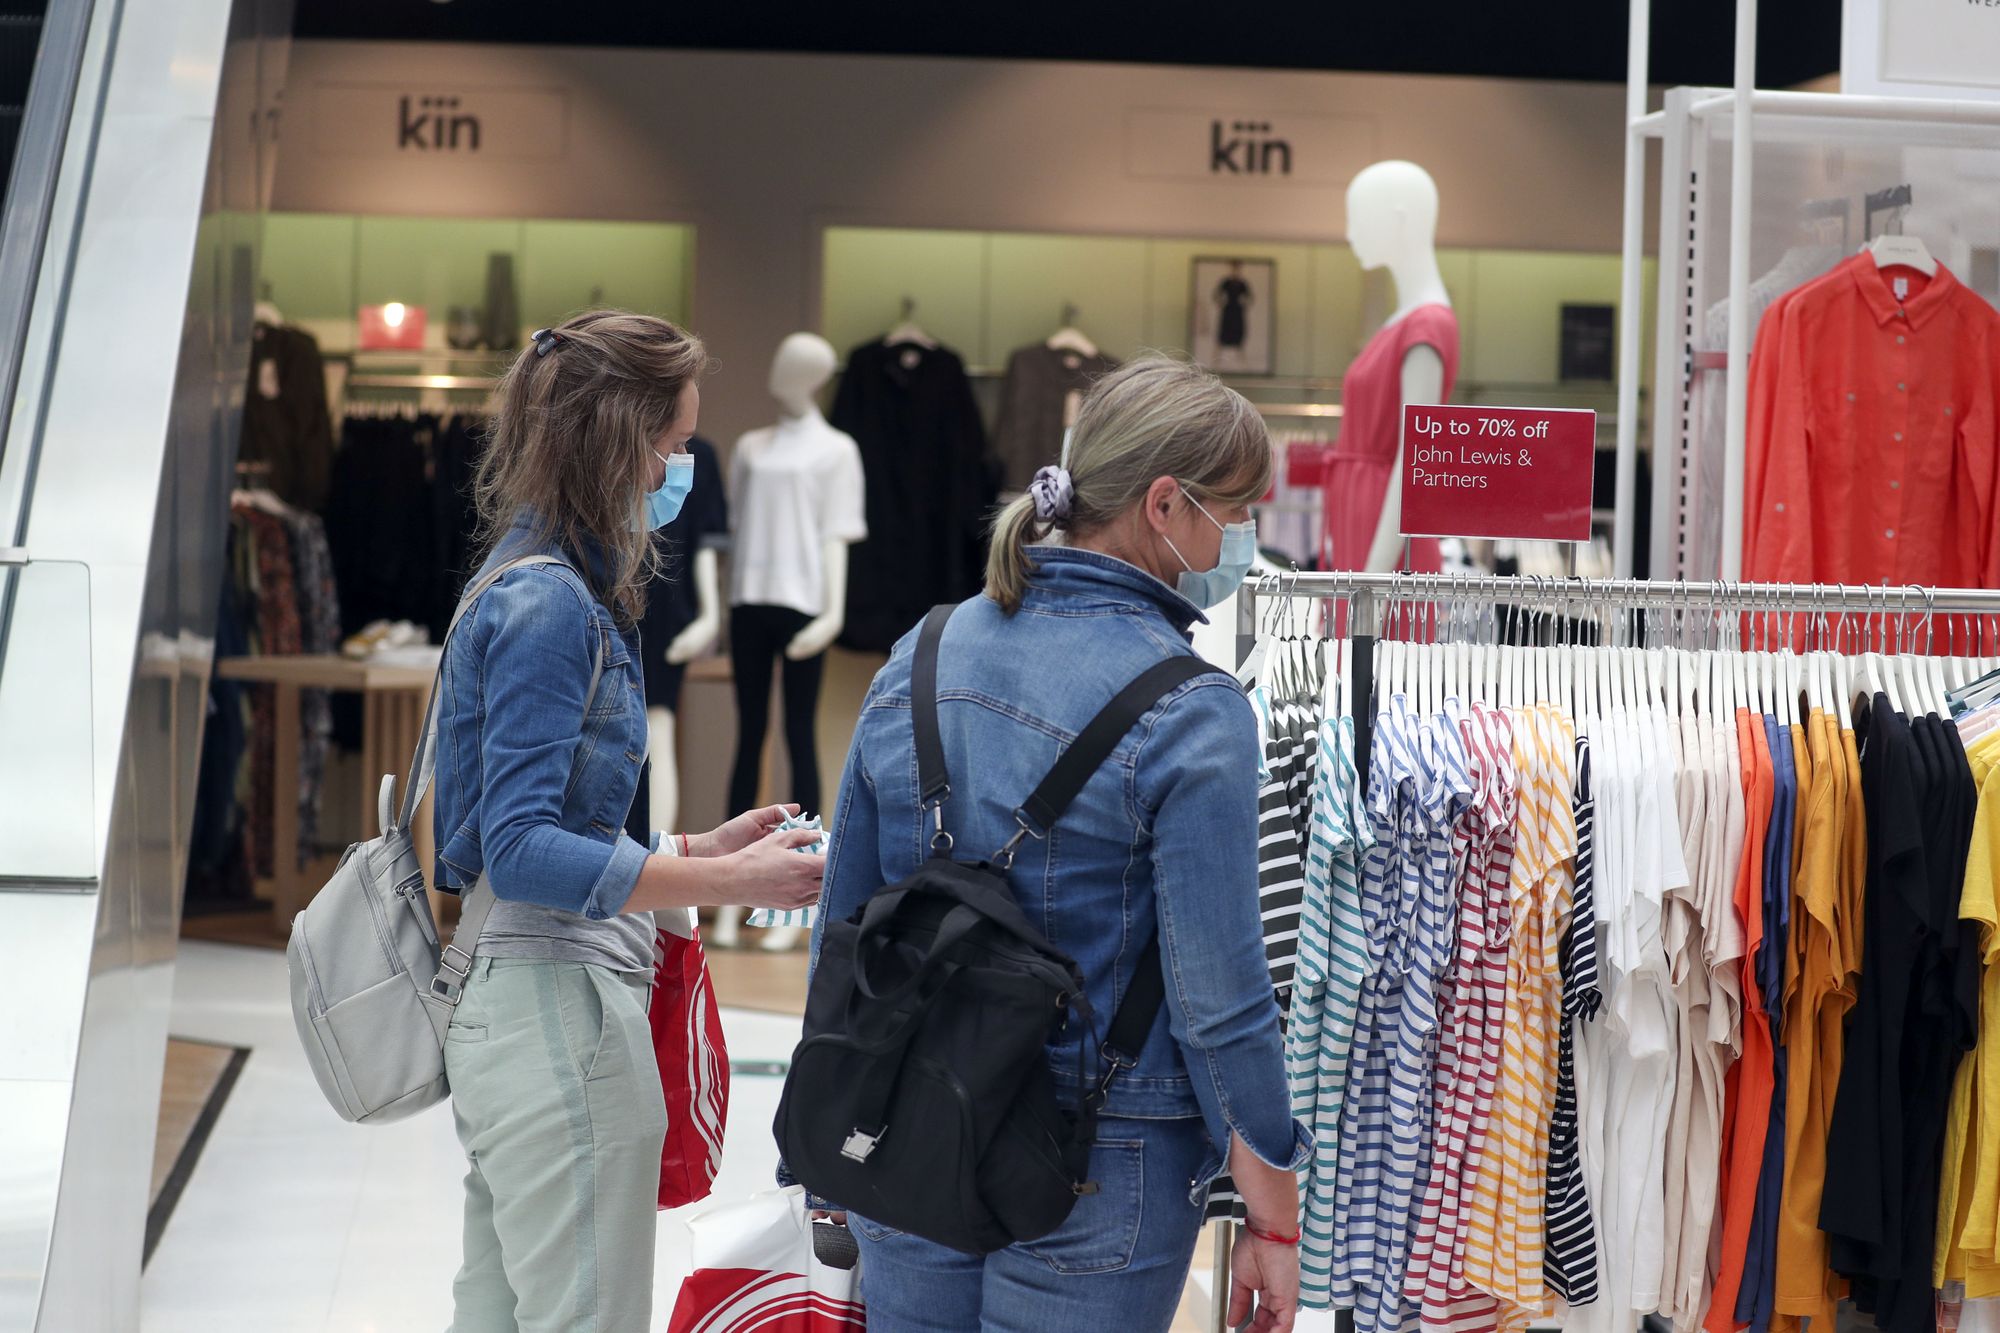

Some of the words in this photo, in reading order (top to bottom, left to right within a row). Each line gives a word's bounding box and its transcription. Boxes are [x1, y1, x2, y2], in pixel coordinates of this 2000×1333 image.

[1414, 415, 1443, 439] Up
[1449, 419, 1470, 435] to
[1478, 418, 1516, 437] 70%
[1523, 421, 1550, 438] off
[1411, 444, 1453, 466] John
[1460, 446, 1512, 465] Lewis
[1517, 448, 1533, 466] &
[1412, 468, 1488, 488] Partners
